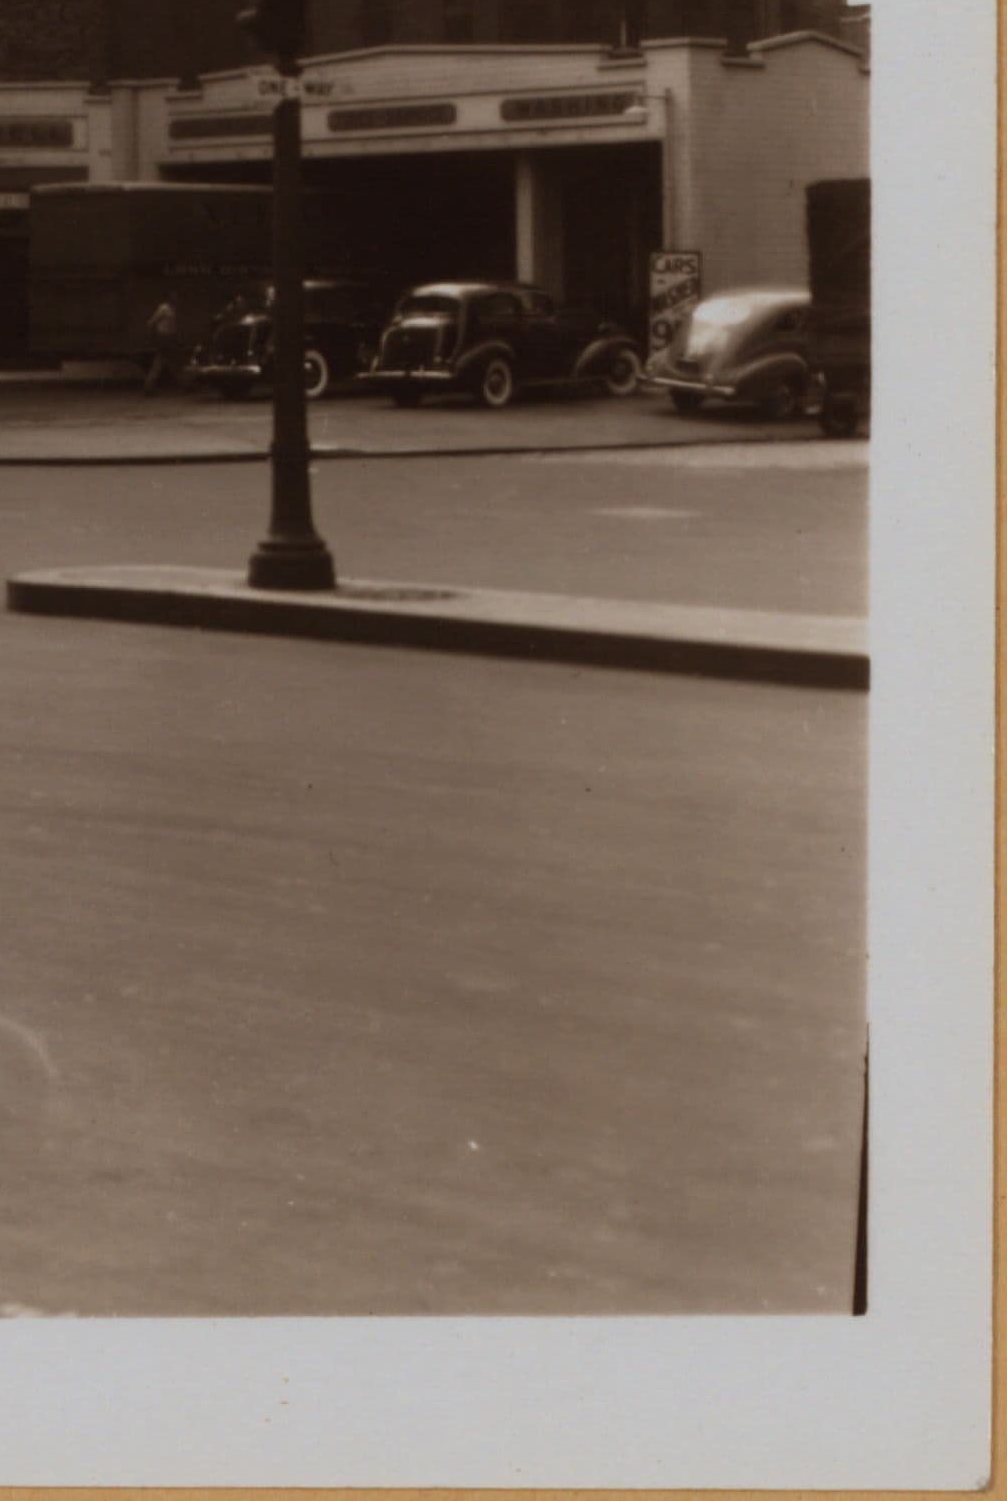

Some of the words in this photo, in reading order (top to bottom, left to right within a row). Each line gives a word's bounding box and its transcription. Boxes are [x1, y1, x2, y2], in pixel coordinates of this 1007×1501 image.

[257, 80, 286, 96] ONE
[304, 81, 334, 96] WAY
[651, 255, 697, 275] CARS
